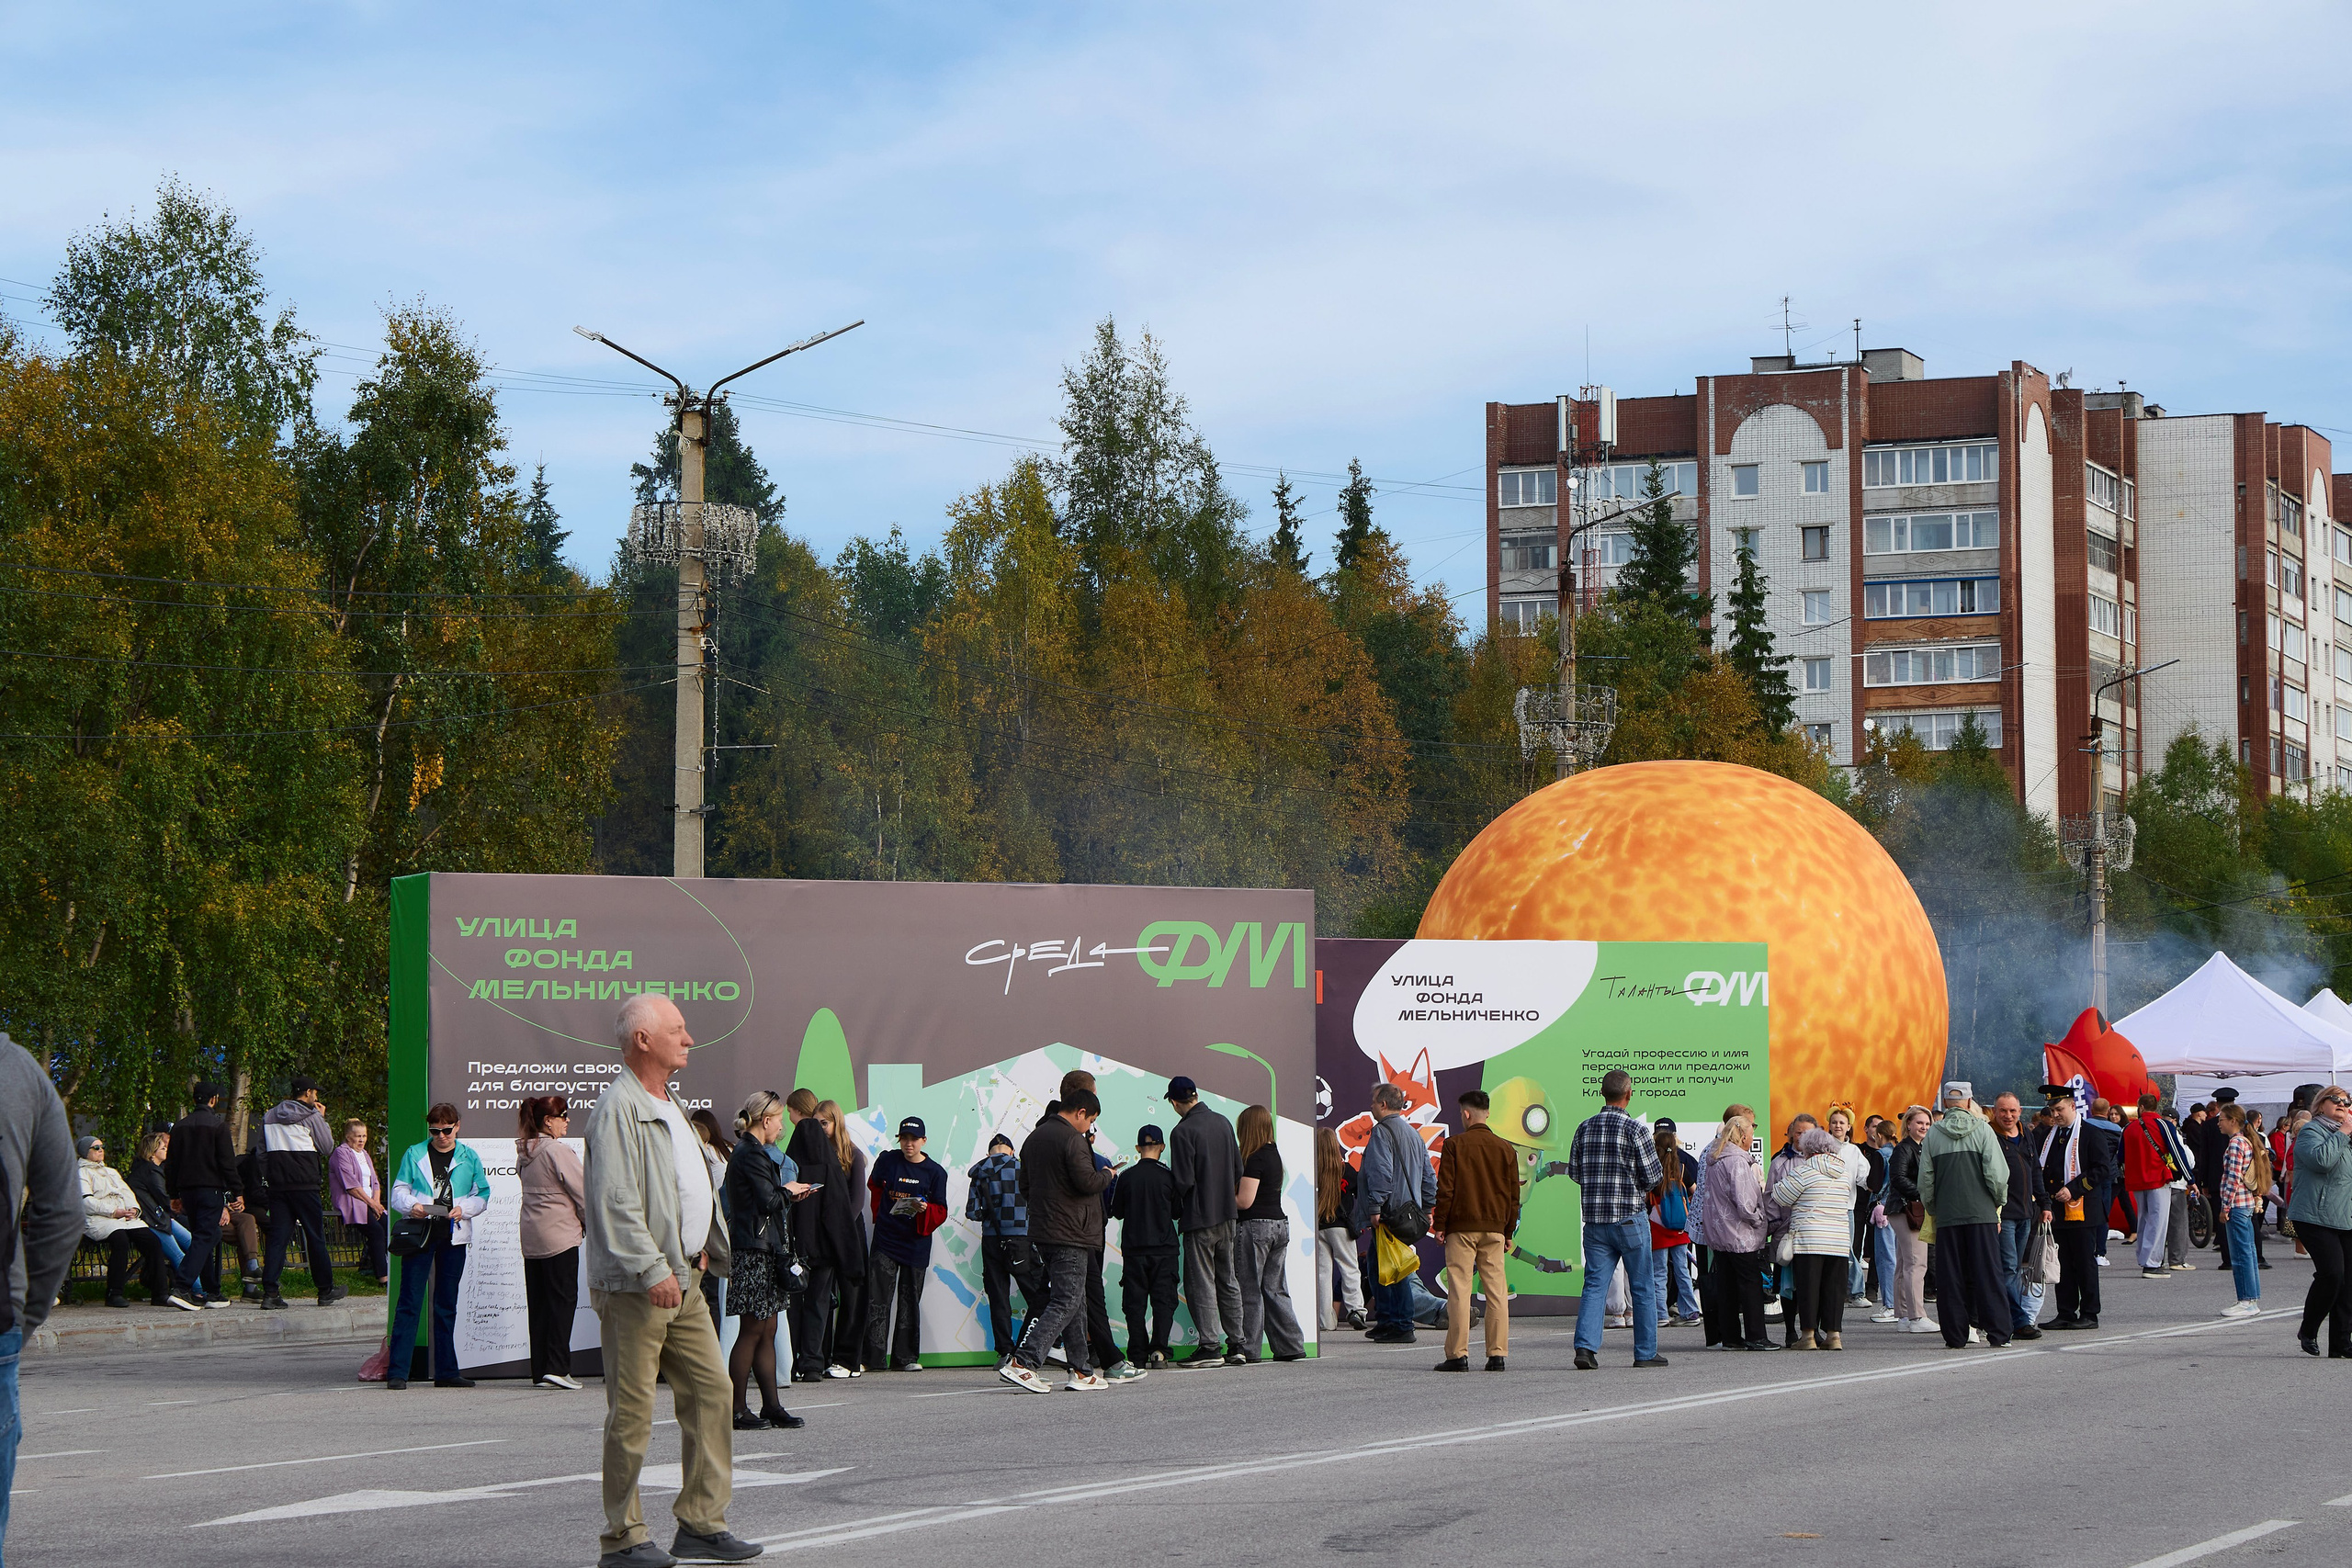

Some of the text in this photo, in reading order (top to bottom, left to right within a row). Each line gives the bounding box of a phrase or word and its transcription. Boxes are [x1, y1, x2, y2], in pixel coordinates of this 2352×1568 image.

[455, 917, 578, 941] УЛИЦА
[504, 948, 633, 972] ФОНДА
[1391, 975, 1454, 987] УЛИЦА
[468, 979, 741, 1001] МЕЛЬНИЧЕНКО
[1416, 992, 1483, 1005] ФОНДА
[1397, 1010, 1540, 1021] МЕЛЬНИЧЕНКО
[1581, 1049, 1749, 1059] Угадай профессию и имя
[467, 1061, 623, 1077] Предложи свою
[1581, 1063, 1750, 1073] персонажа или предложи
[467, 1081, 504, 1093] для
[1676, 1076, 1685, 1084] и
[1688, 1076, 1734, 1086] получи
[1639, 1089, 1686, 1100] города
[467, 1099, 480, 1110] и
